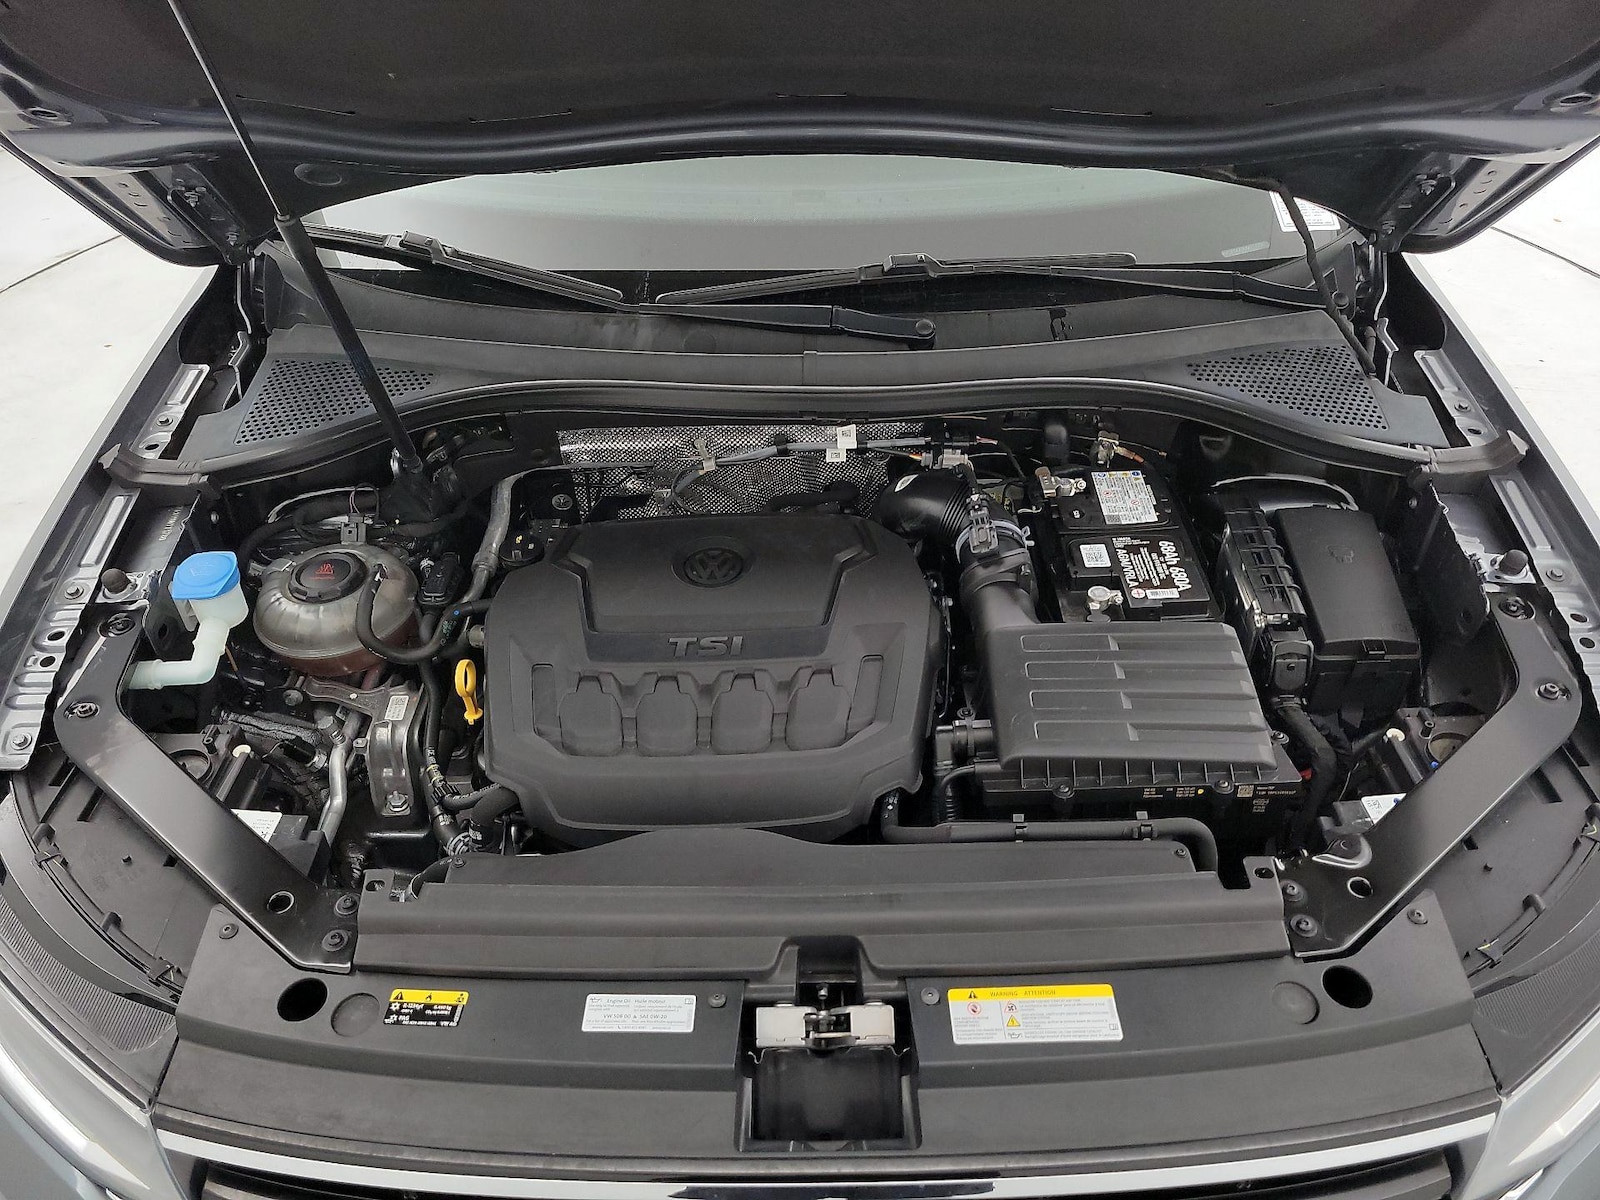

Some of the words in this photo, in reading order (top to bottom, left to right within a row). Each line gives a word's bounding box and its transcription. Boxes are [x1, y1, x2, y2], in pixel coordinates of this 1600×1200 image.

[1158, 540, 1181, 565] 68Ah
[1169, 566, 1192, 592] 680A
[668, 636, 743, 657] TSI
